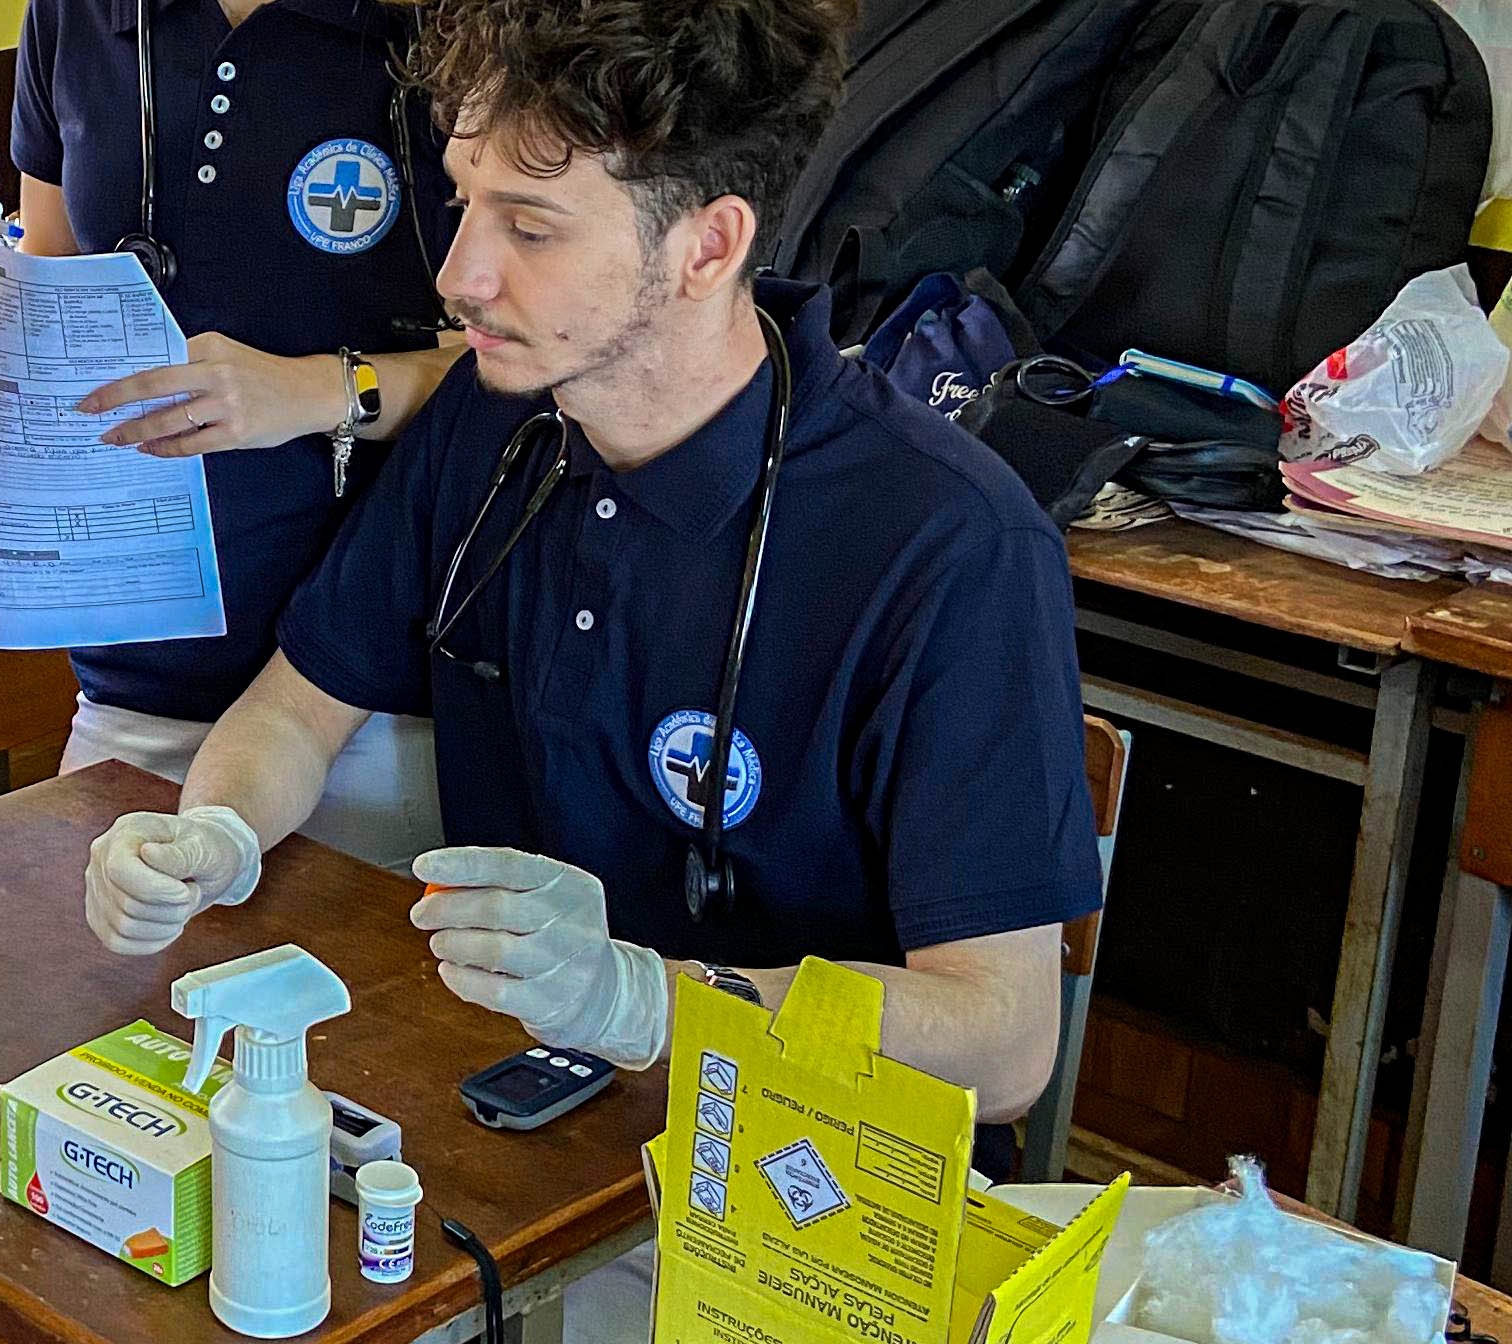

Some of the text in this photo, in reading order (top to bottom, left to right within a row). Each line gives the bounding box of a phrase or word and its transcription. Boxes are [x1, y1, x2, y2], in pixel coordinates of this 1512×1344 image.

[332, 235, 372, 251] FRANCO
[124, 1033, 193, 1062] AUTO
[760, 1087, 805, 1114] PELIGRO
[815, 1111, 855, 1137] PERIGO
[756, 1270, 843, 1323] MANUSEIE
[788, 1266, 896, 1327] PELAS ALÇAS
